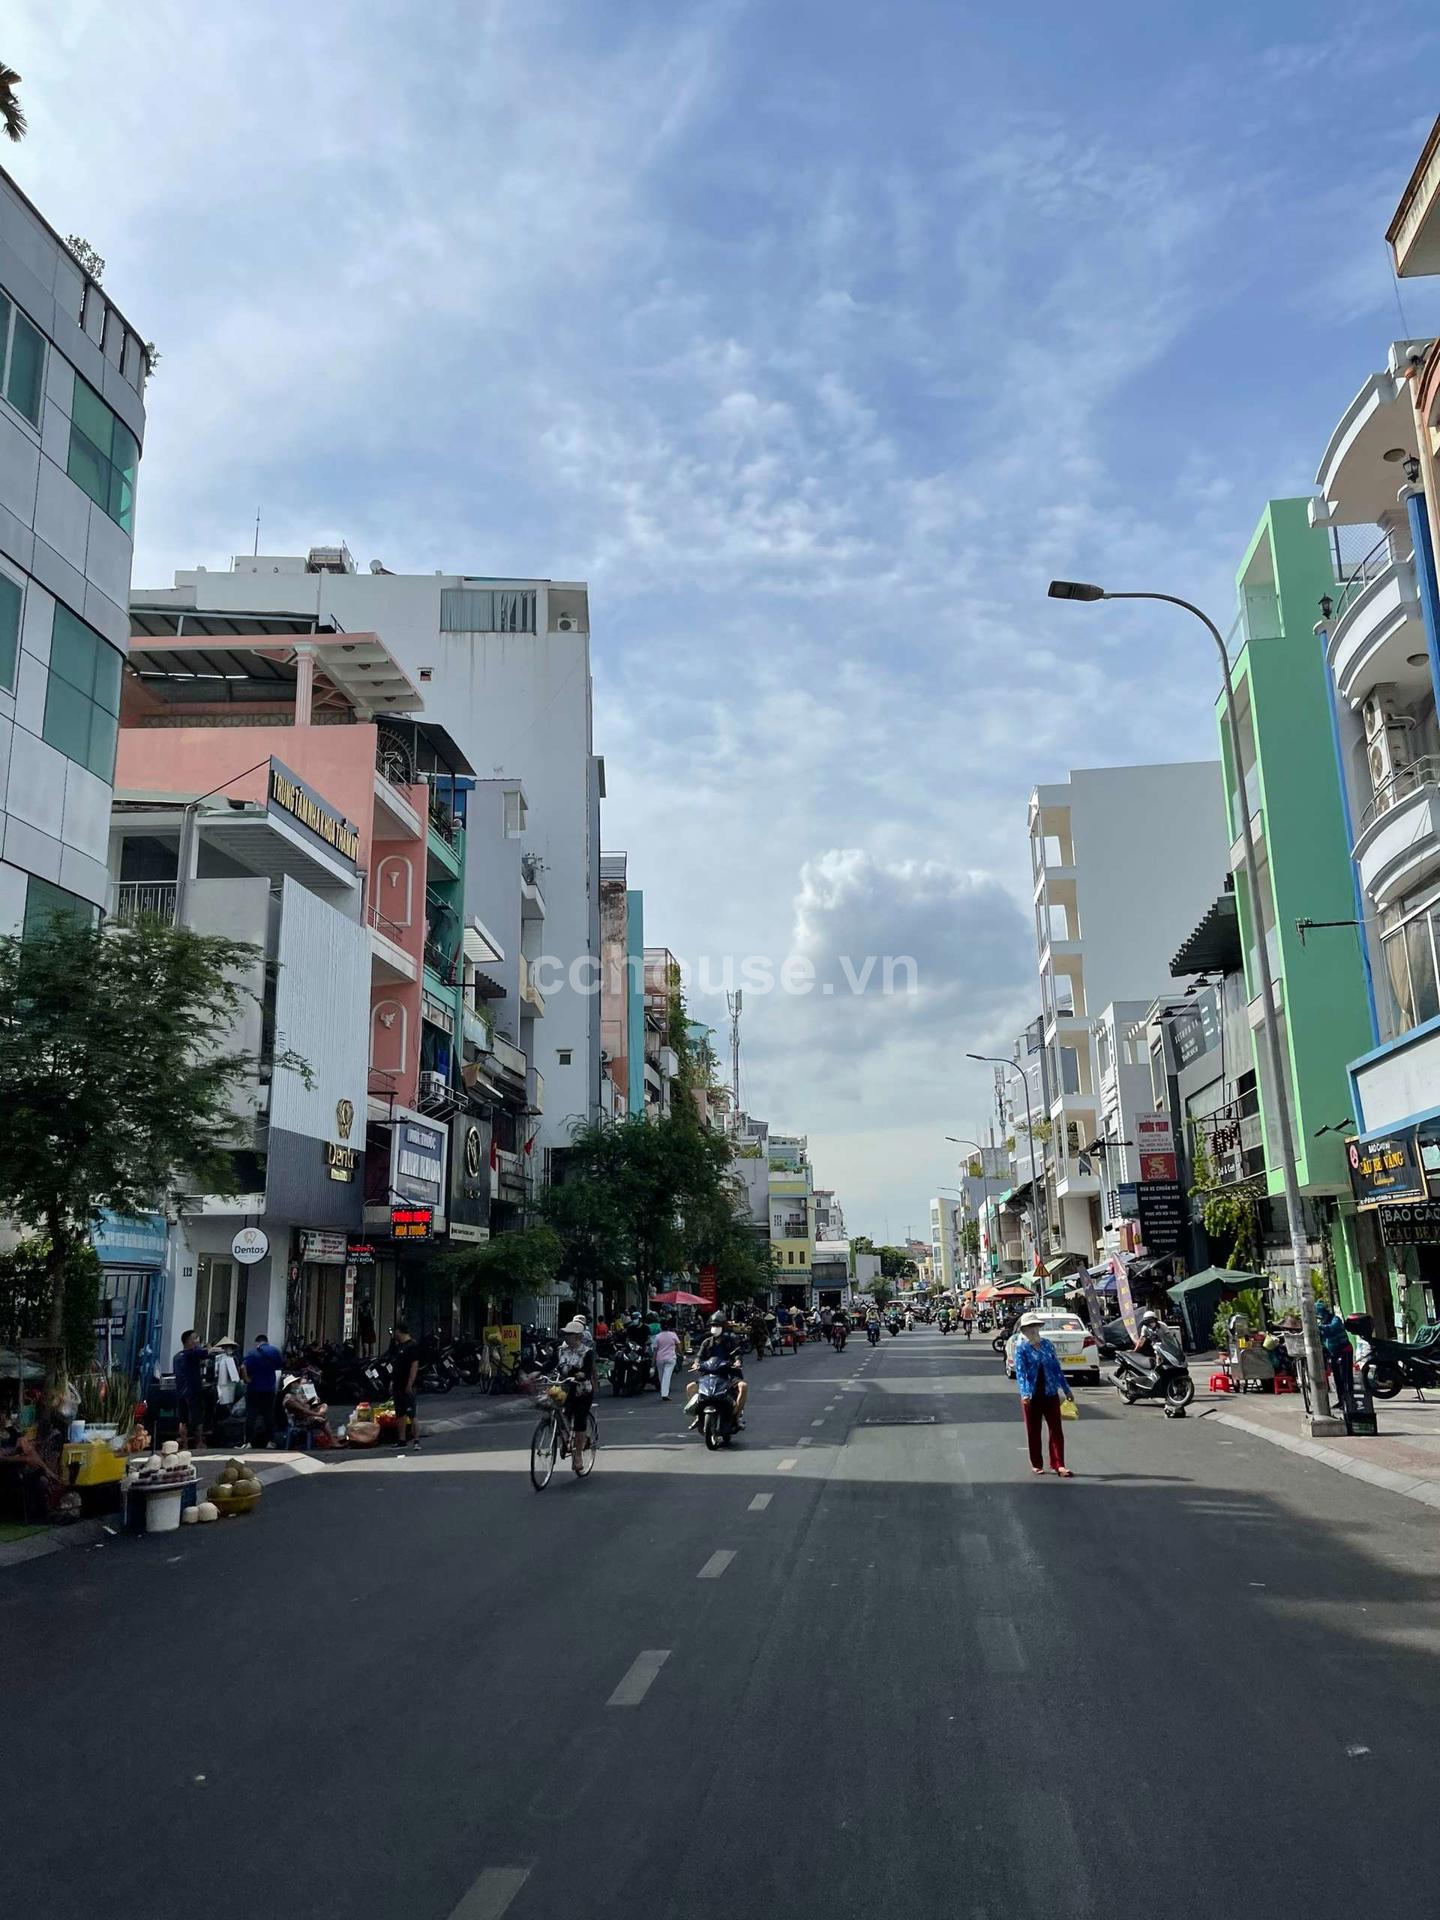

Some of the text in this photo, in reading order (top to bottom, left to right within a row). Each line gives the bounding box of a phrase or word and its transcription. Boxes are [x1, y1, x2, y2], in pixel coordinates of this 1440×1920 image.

[273, 771, 295, 812] TRUNG
[1383, 1150, 1404, 1170] VÀNG
[1384, 1209, 1411, 1221] BAO
[234, 1245, 264, 1254] Dentos
